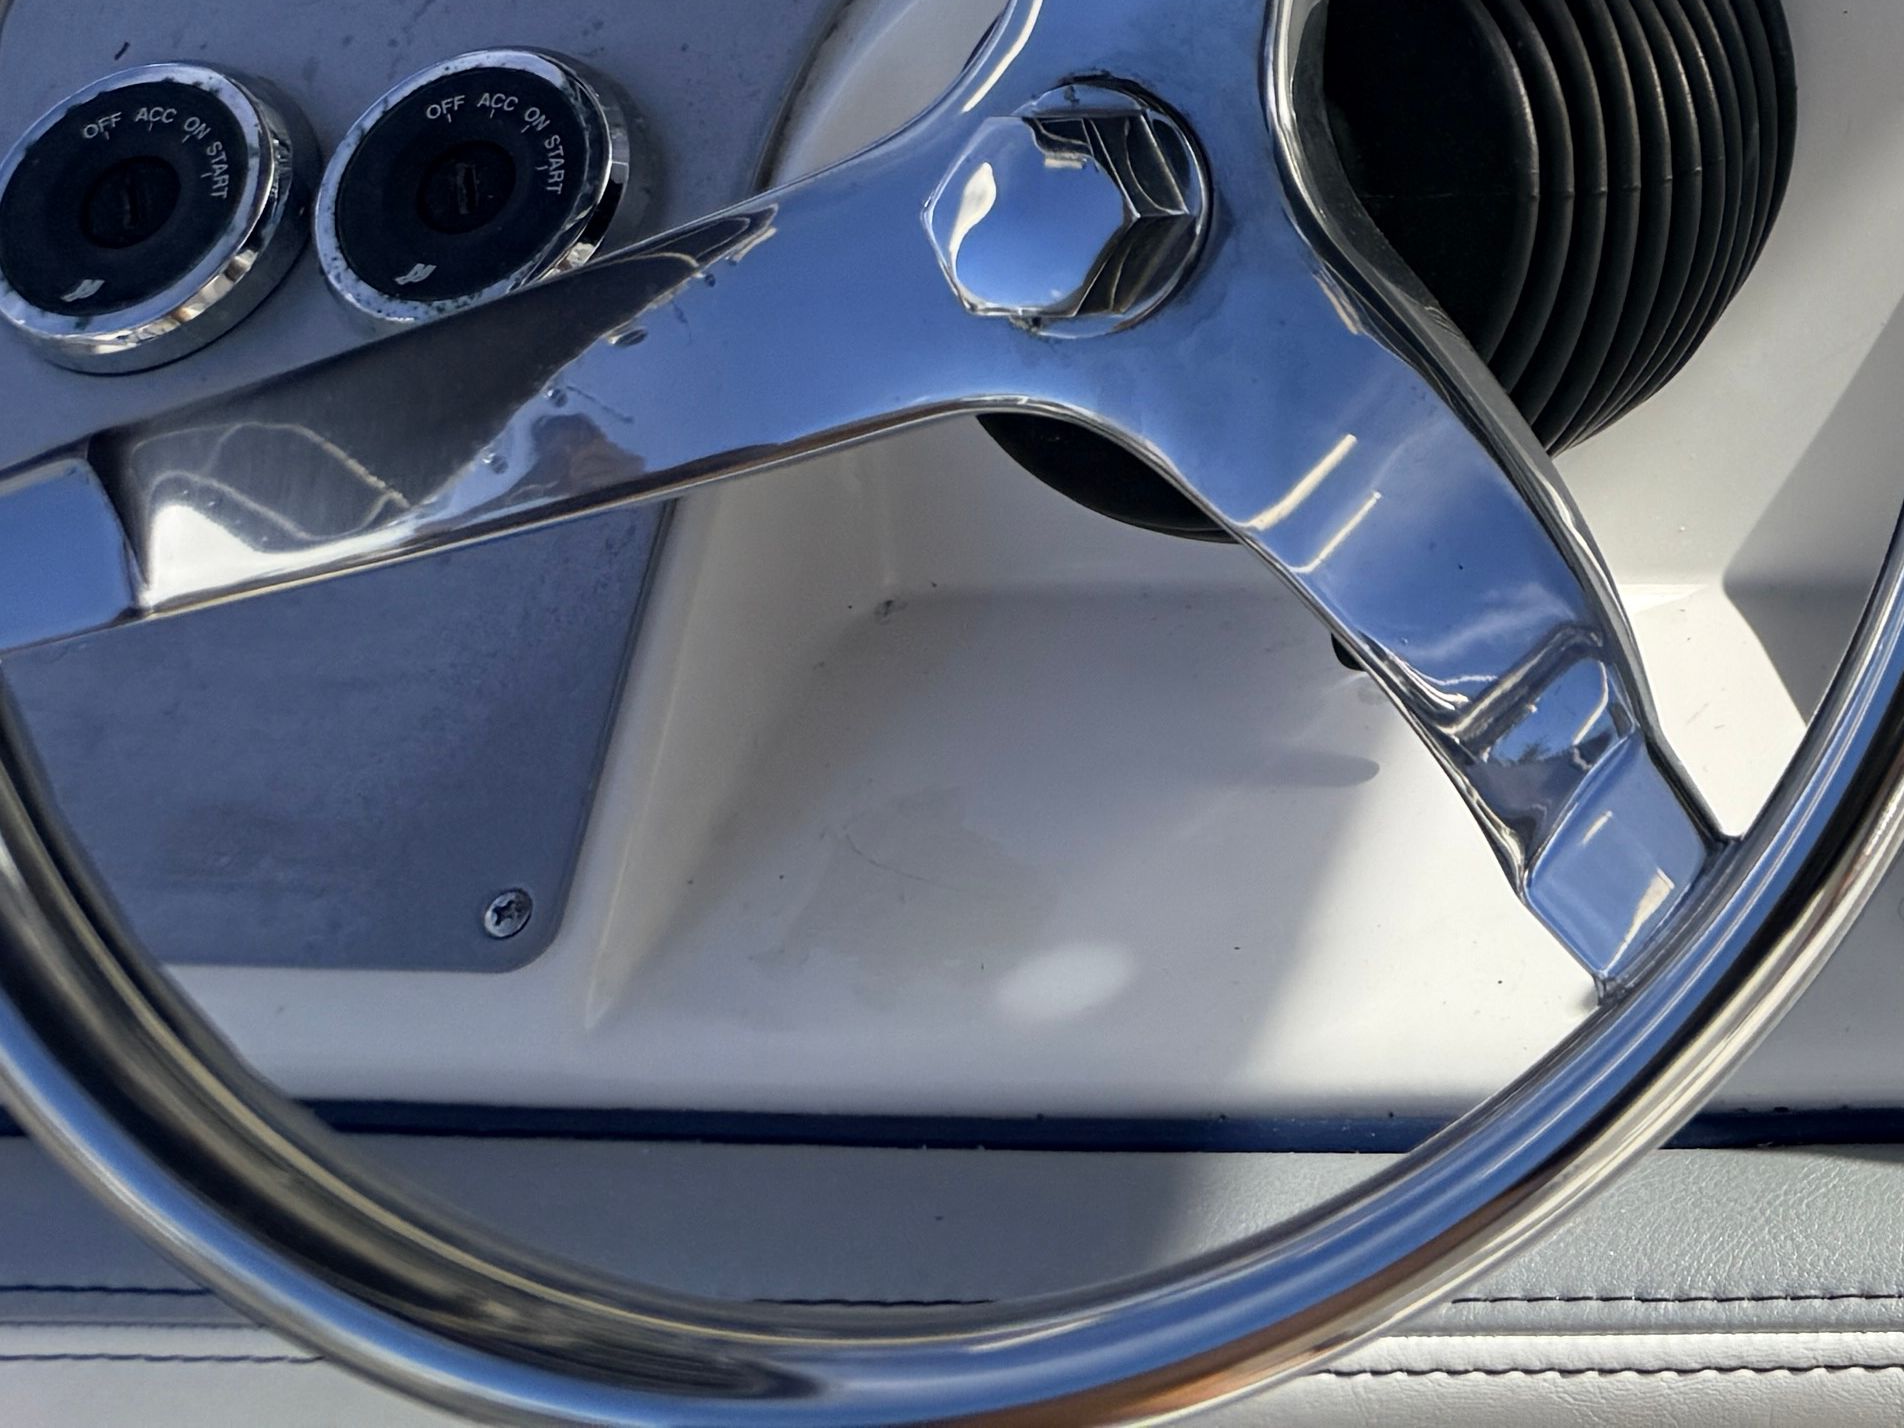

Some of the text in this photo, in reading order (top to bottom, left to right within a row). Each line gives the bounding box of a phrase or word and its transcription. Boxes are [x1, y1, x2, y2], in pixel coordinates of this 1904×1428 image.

[83, 106, 229, 200] OFF ACC ON START
[426, 92, 566, 194] OFF ACC ON START
